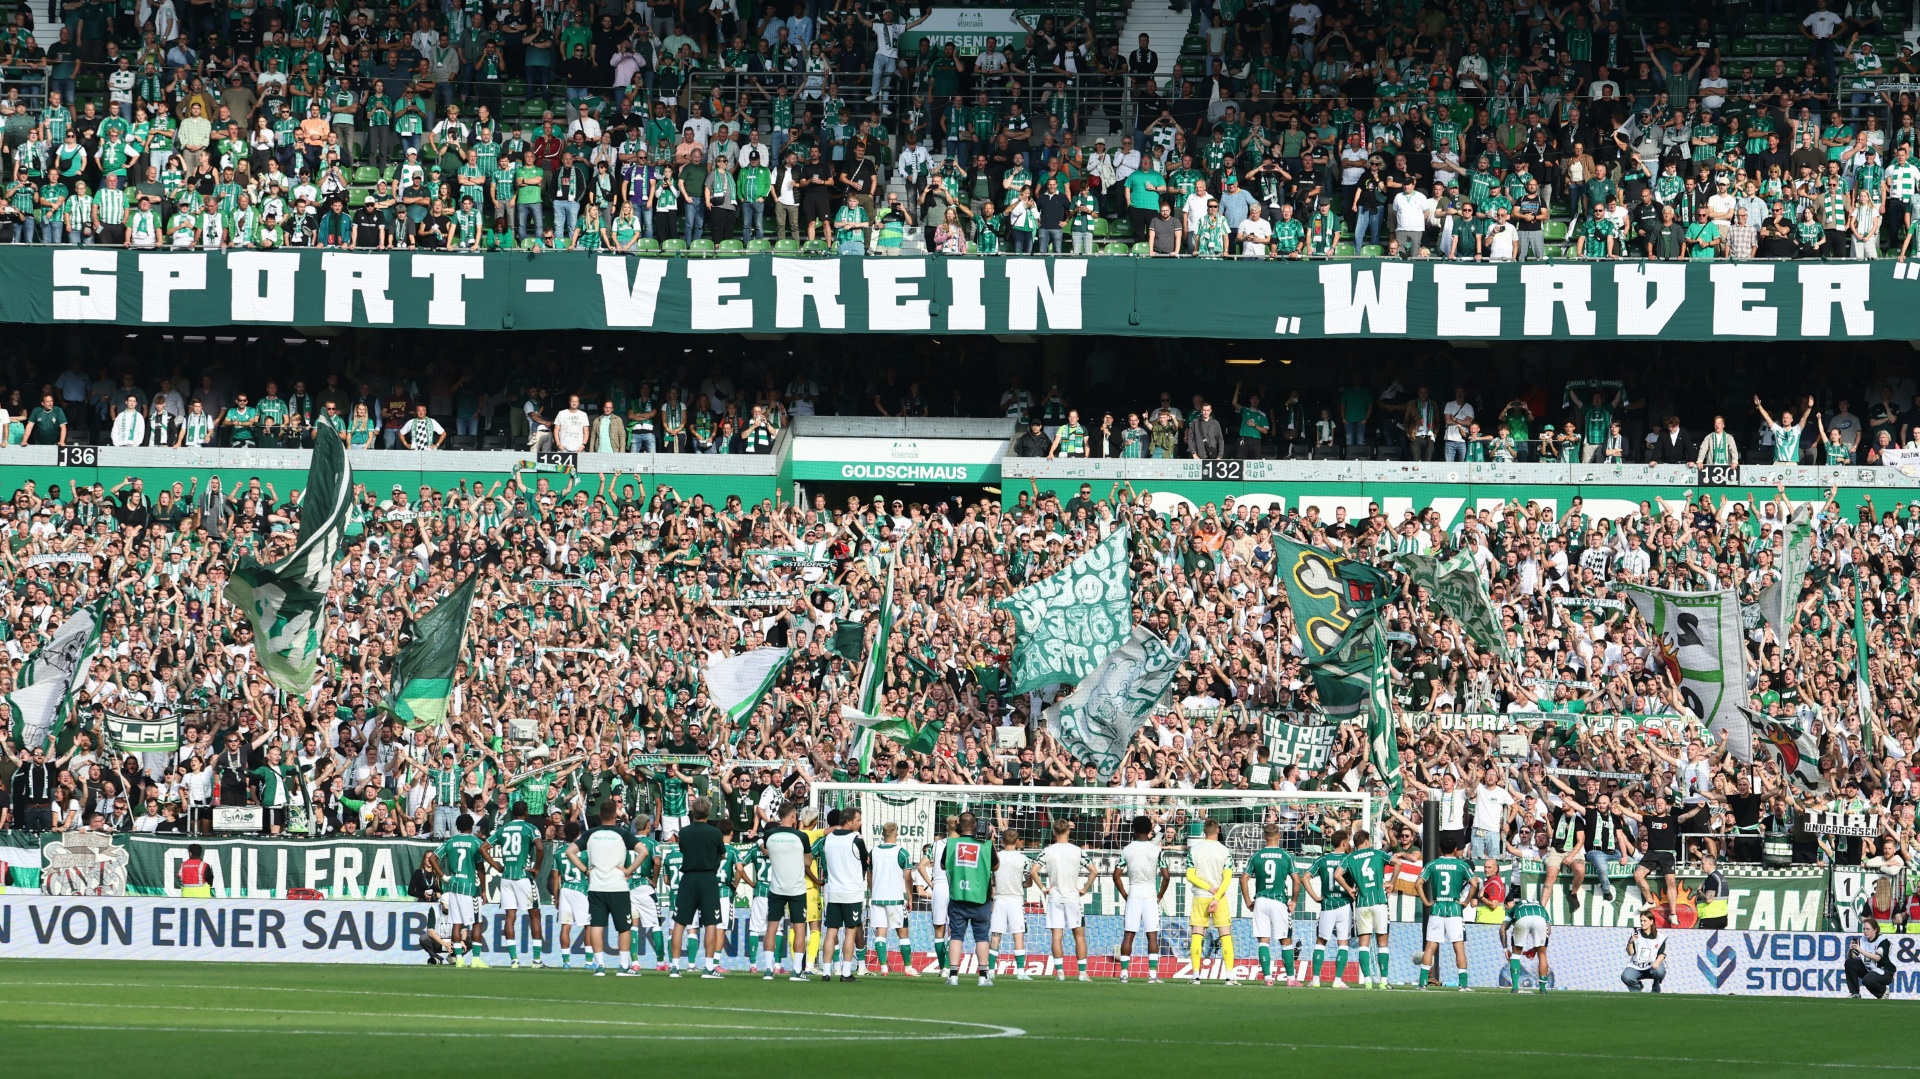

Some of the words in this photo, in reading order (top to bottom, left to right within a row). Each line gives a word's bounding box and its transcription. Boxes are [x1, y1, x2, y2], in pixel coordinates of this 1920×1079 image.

[53, 249, 484, 326] SPORT
[596, 255, 1088, 331] VEREIN
[60, 448, 94, 466] 136
[842, 465, 967, 480] GOLDSCHMAUS
[1205, 461, 1239, 478] 132
[1701, 467, 1738, 483] 130
[753, 597, 792, 606] BREMEN
[1263, 714, 1336, 744] ULTRAS
[1545, 766, 1588, 776] WERDER
[1600, 772, 1643, 780] BREMEN
[872, 825, 924, 836] WDER
[1805, 823, 1877, 836] UNVERGESSEN
[452, 841, 472, 849] WERDER
[502, 832, 522, 856] 28
[458, 848, 467, 871] 7
[1264, 859, 1276, 883] 9
[1361, 858, 1375, 881] 4
[960, 881, 971, 890] 01
[1441, 871, 1450, 896] 3
[1728, 889, 1822, 932] FAM
[28, 905, 132, 945] VON
[152, 907, 286, 949] EINER
